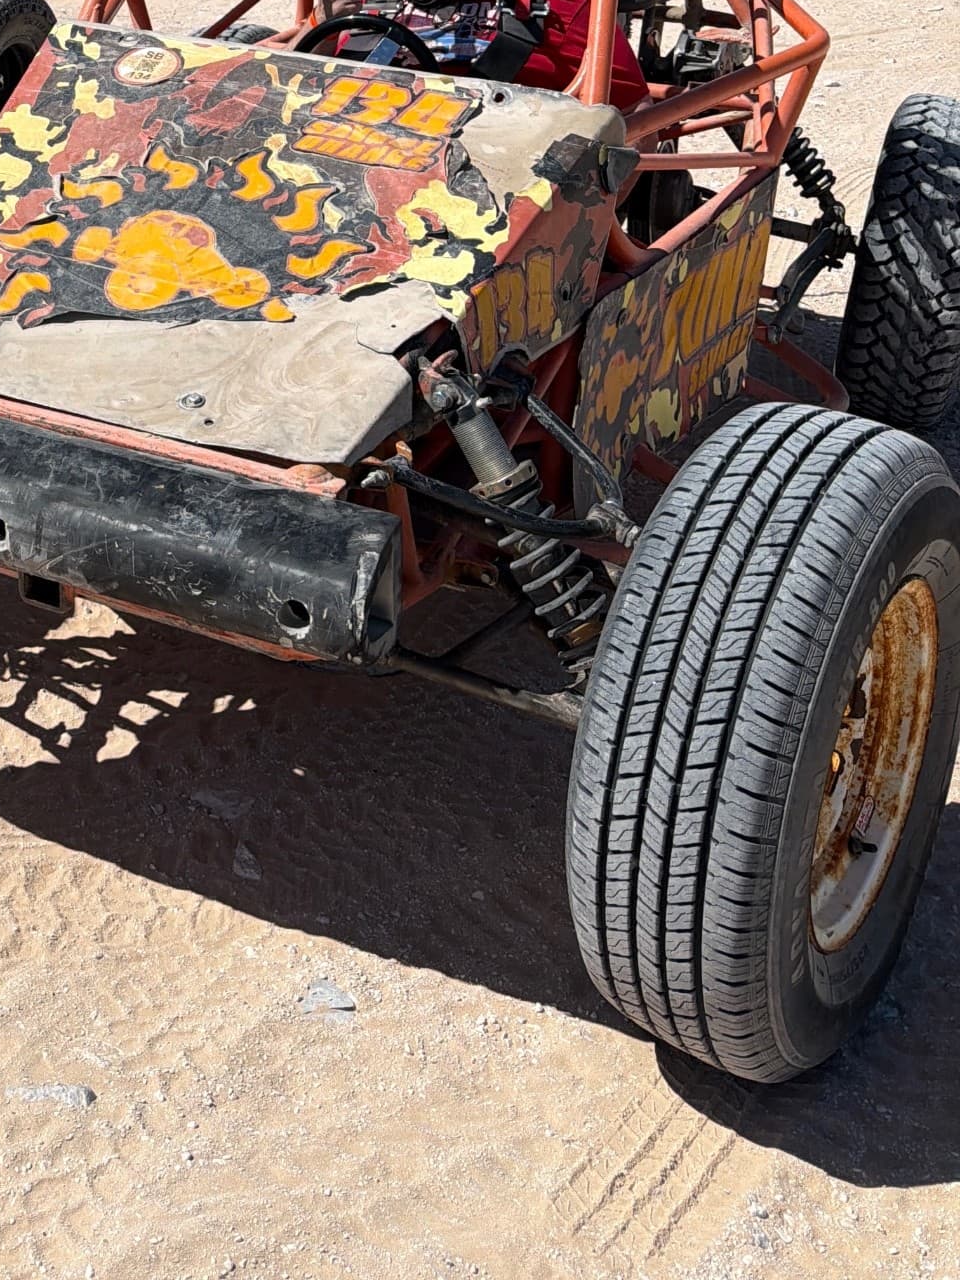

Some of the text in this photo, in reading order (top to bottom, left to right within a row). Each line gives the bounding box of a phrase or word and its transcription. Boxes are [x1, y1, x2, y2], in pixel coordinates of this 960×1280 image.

[144, 50, 165, 60] SB
[128, 71, 152, 80] 134
[310, 75, 474, 137] 134
